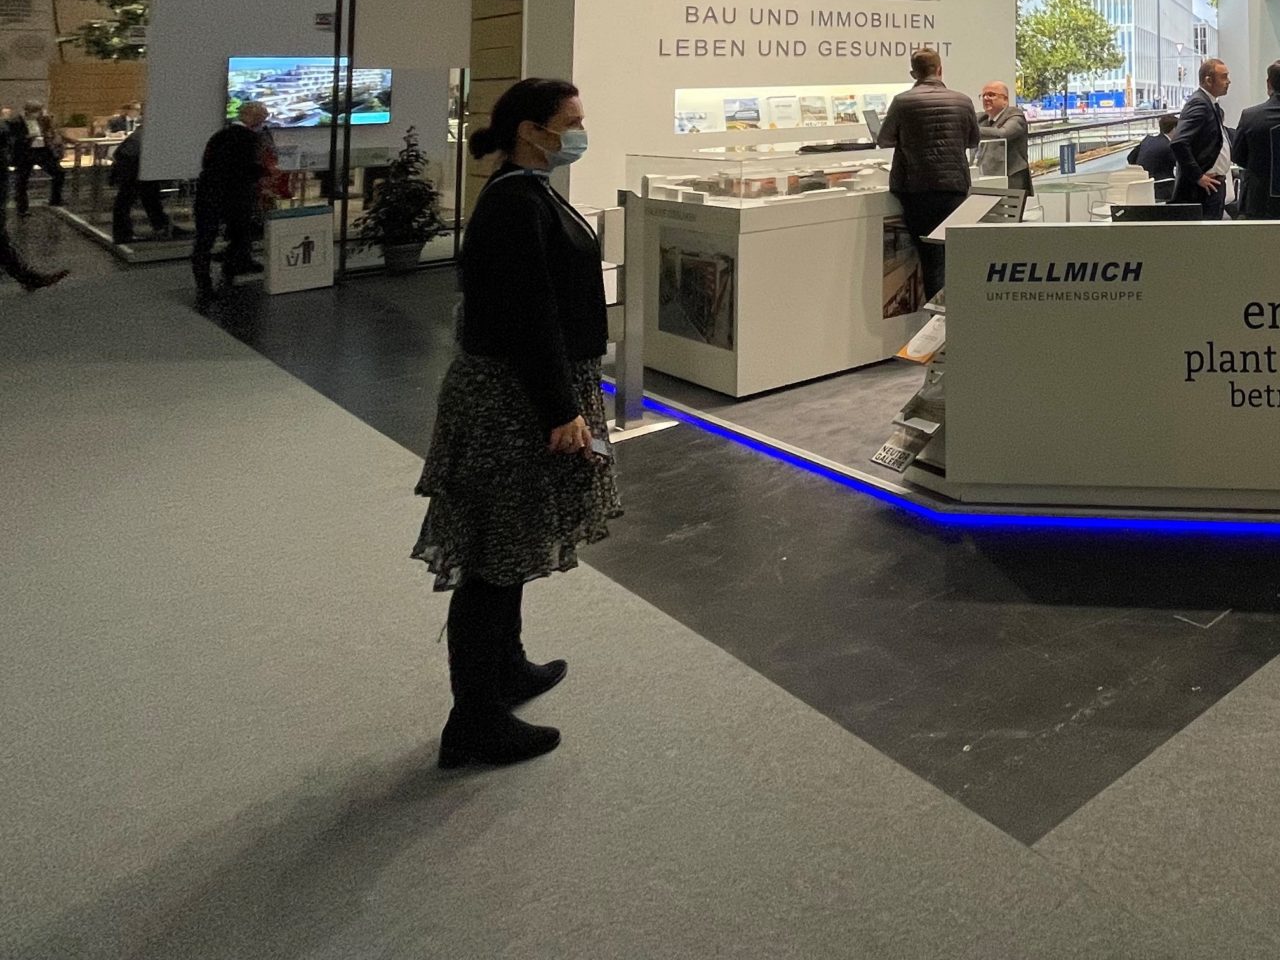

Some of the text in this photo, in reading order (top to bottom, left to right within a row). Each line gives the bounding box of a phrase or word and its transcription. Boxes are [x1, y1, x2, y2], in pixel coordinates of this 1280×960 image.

[685, 5, 936, 29] BAU UND IMMOBILIEN
[658, 38, 746, 57] LEBEN
[757, 40, 807, 57] UND
[986, 262, 1143, 282] HELLMICH
[986, 291, 1143, 301] UNTERNEHMENSGRUPPE
[1184, 341, 1277, 382] plant
